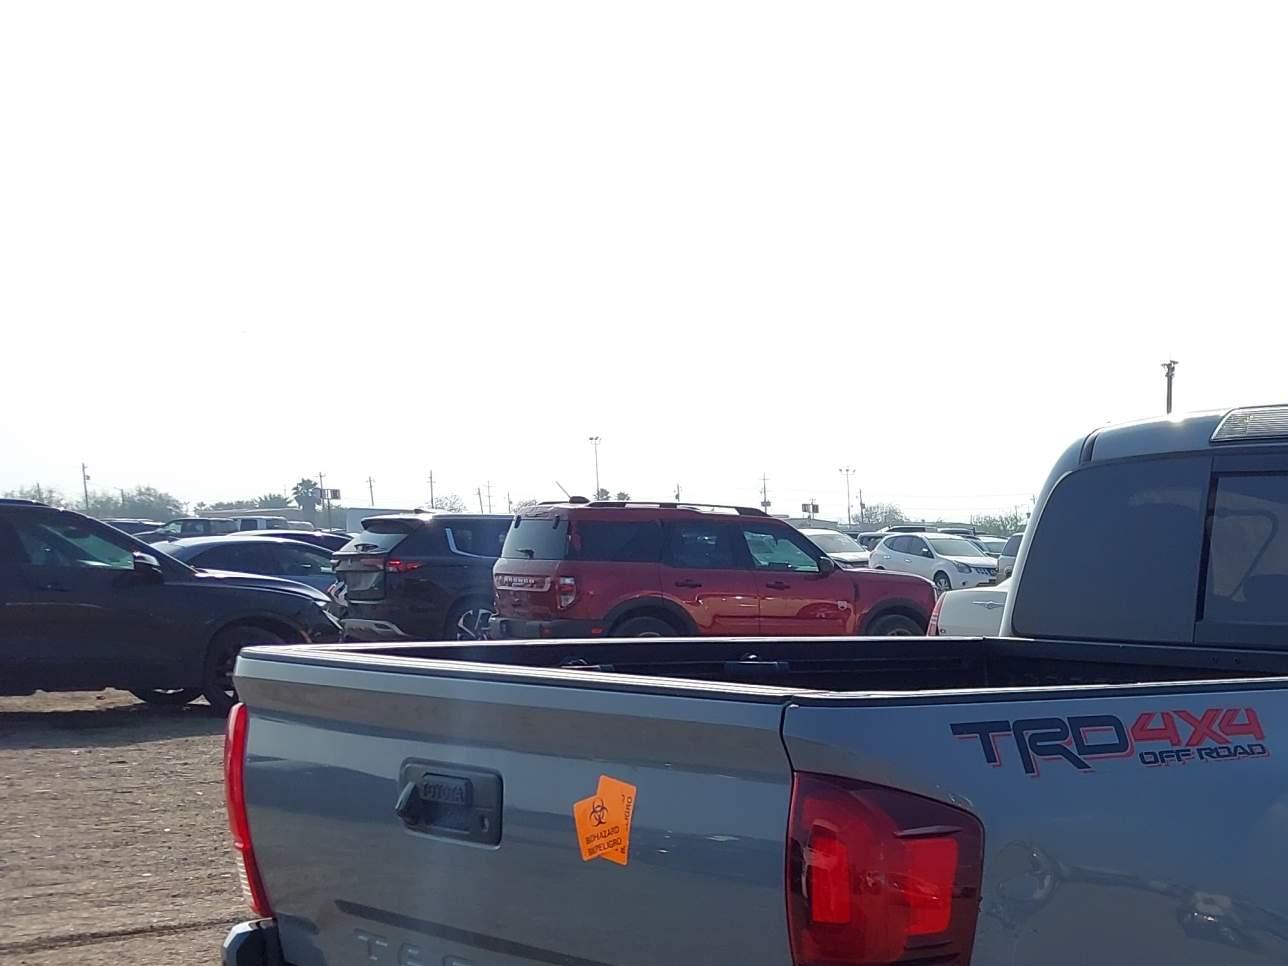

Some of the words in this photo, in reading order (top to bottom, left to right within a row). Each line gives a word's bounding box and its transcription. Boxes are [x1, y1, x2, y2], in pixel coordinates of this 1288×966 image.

[949, 714, 1135, 778] TRD
[1138, 749, 1194, 768] OFF
[1196, 743, 1270, 763] ROAD
